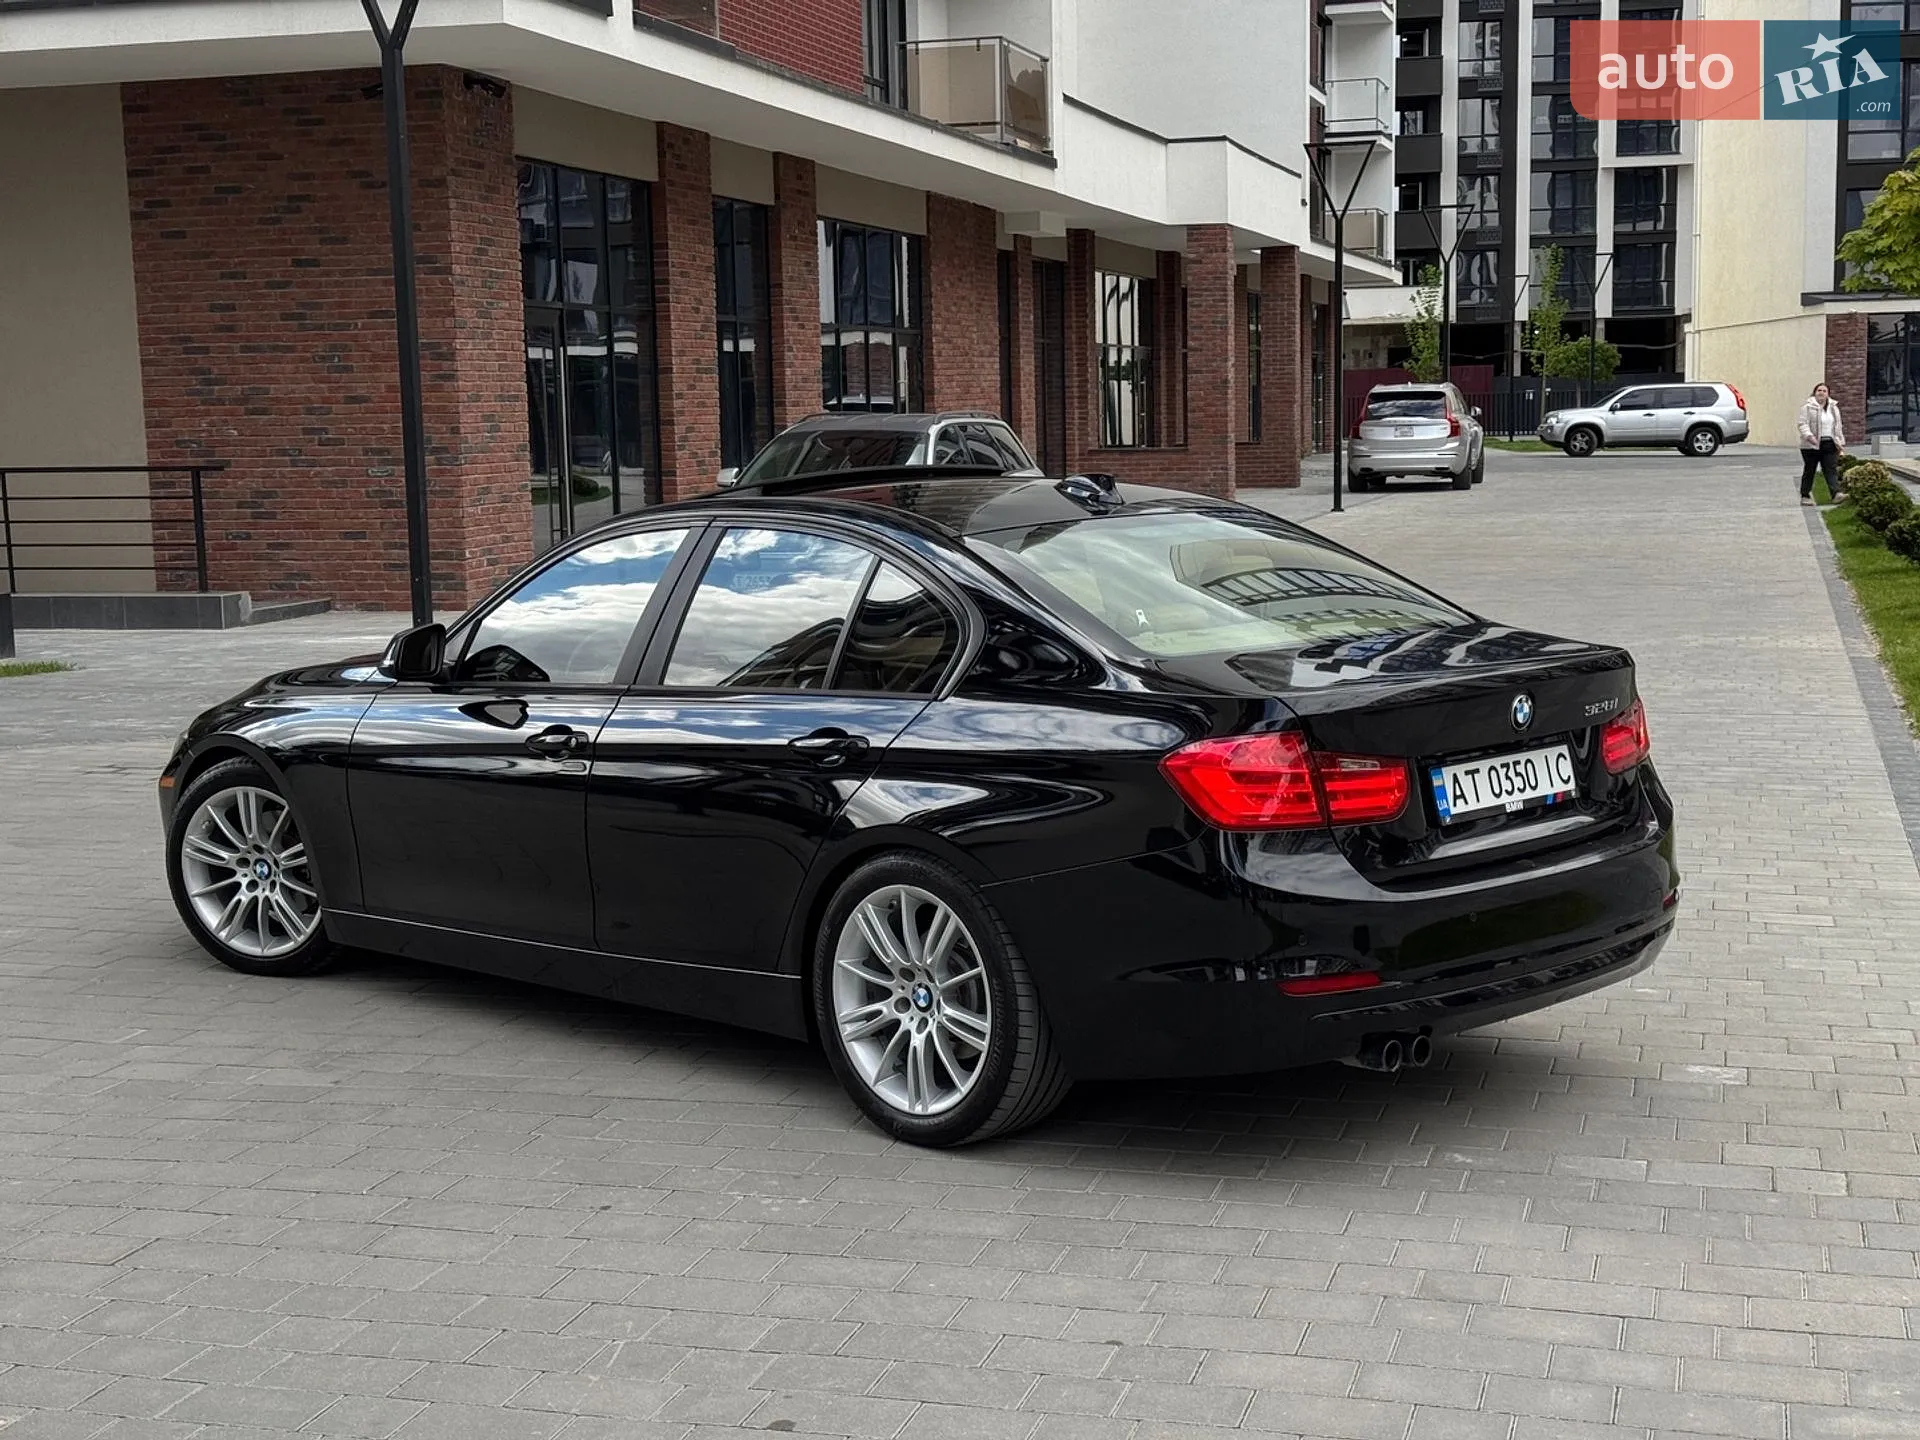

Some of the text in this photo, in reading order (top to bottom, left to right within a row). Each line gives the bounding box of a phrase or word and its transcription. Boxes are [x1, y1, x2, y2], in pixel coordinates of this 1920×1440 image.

[1452, 752, 1571, 807] AT 0350 IC
